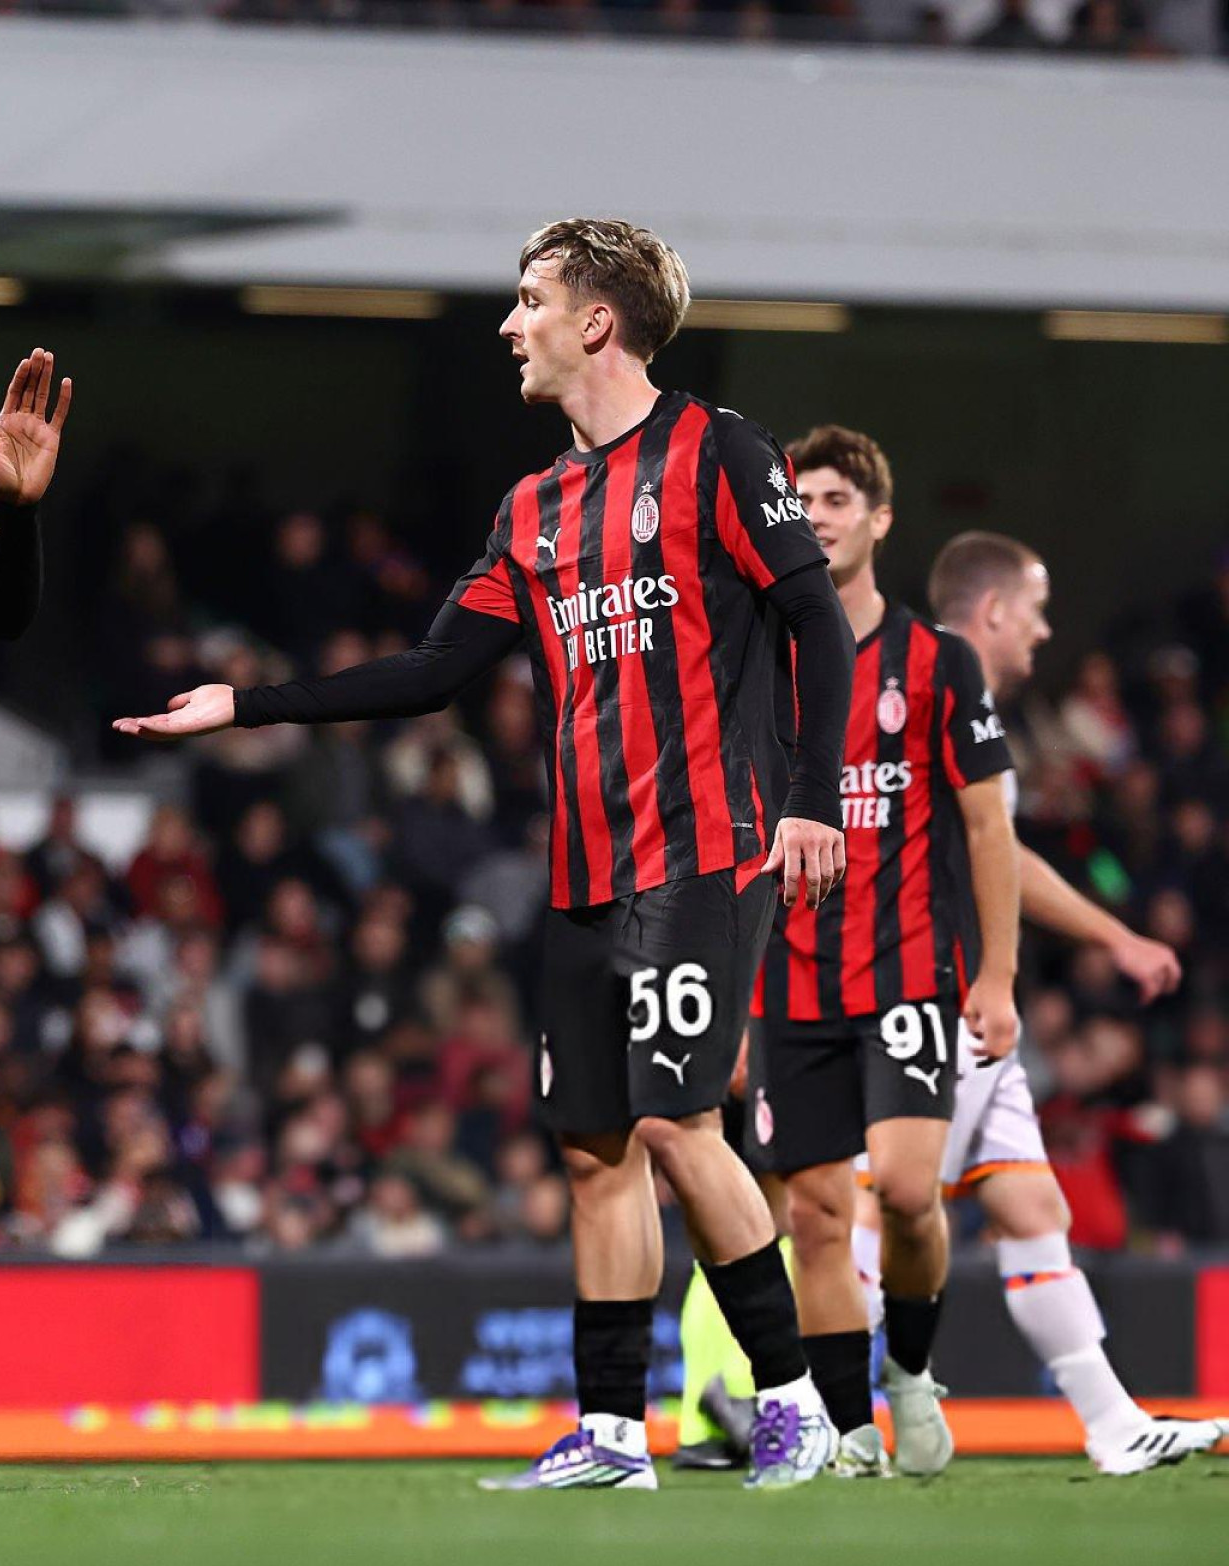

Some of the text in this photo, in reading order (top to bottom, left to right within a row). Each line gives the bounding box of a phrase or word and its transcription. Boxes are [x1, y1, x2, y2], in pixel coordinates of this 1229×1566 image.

[546, 573, 679, 636] Emirates
[584, 617, 654, 665] BETTER
[629, 962, 712, 1042] 56
[879, 1002, 947, 1063] 91
